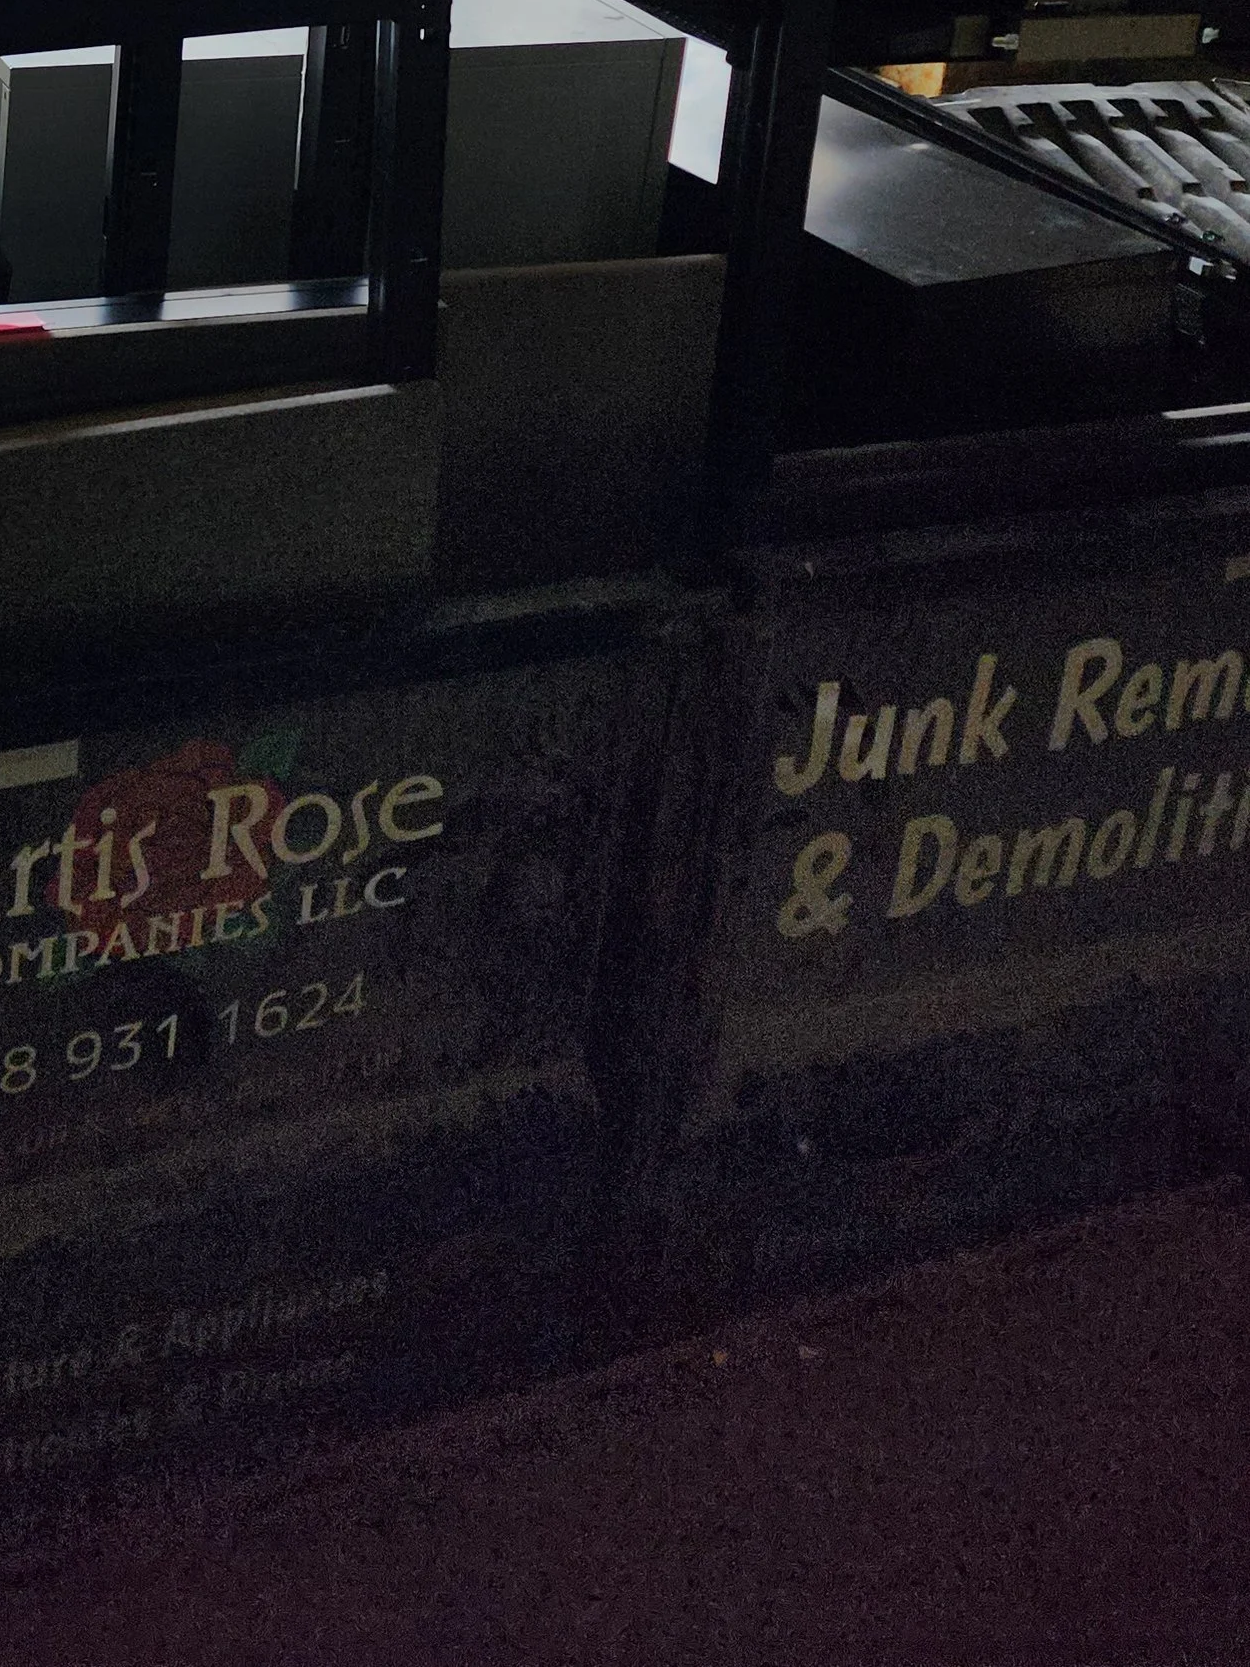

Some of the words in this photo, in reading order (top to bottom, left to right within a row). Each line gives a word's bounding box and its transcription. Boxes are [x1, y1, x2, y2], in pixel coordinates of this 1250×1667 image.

[773, 653, 1018, 797] Junk
[1048, 636, 1250, 751] Rem
[200, 774, 444, 881] Rose
[296, 866, 408, 925] LLC
[775, 831, 853, 938] &
[65, 1014, 181, 1081] 931
[216, 972, 367, 1045] 1624
[160, 1269, 389, 1358] Appliances
